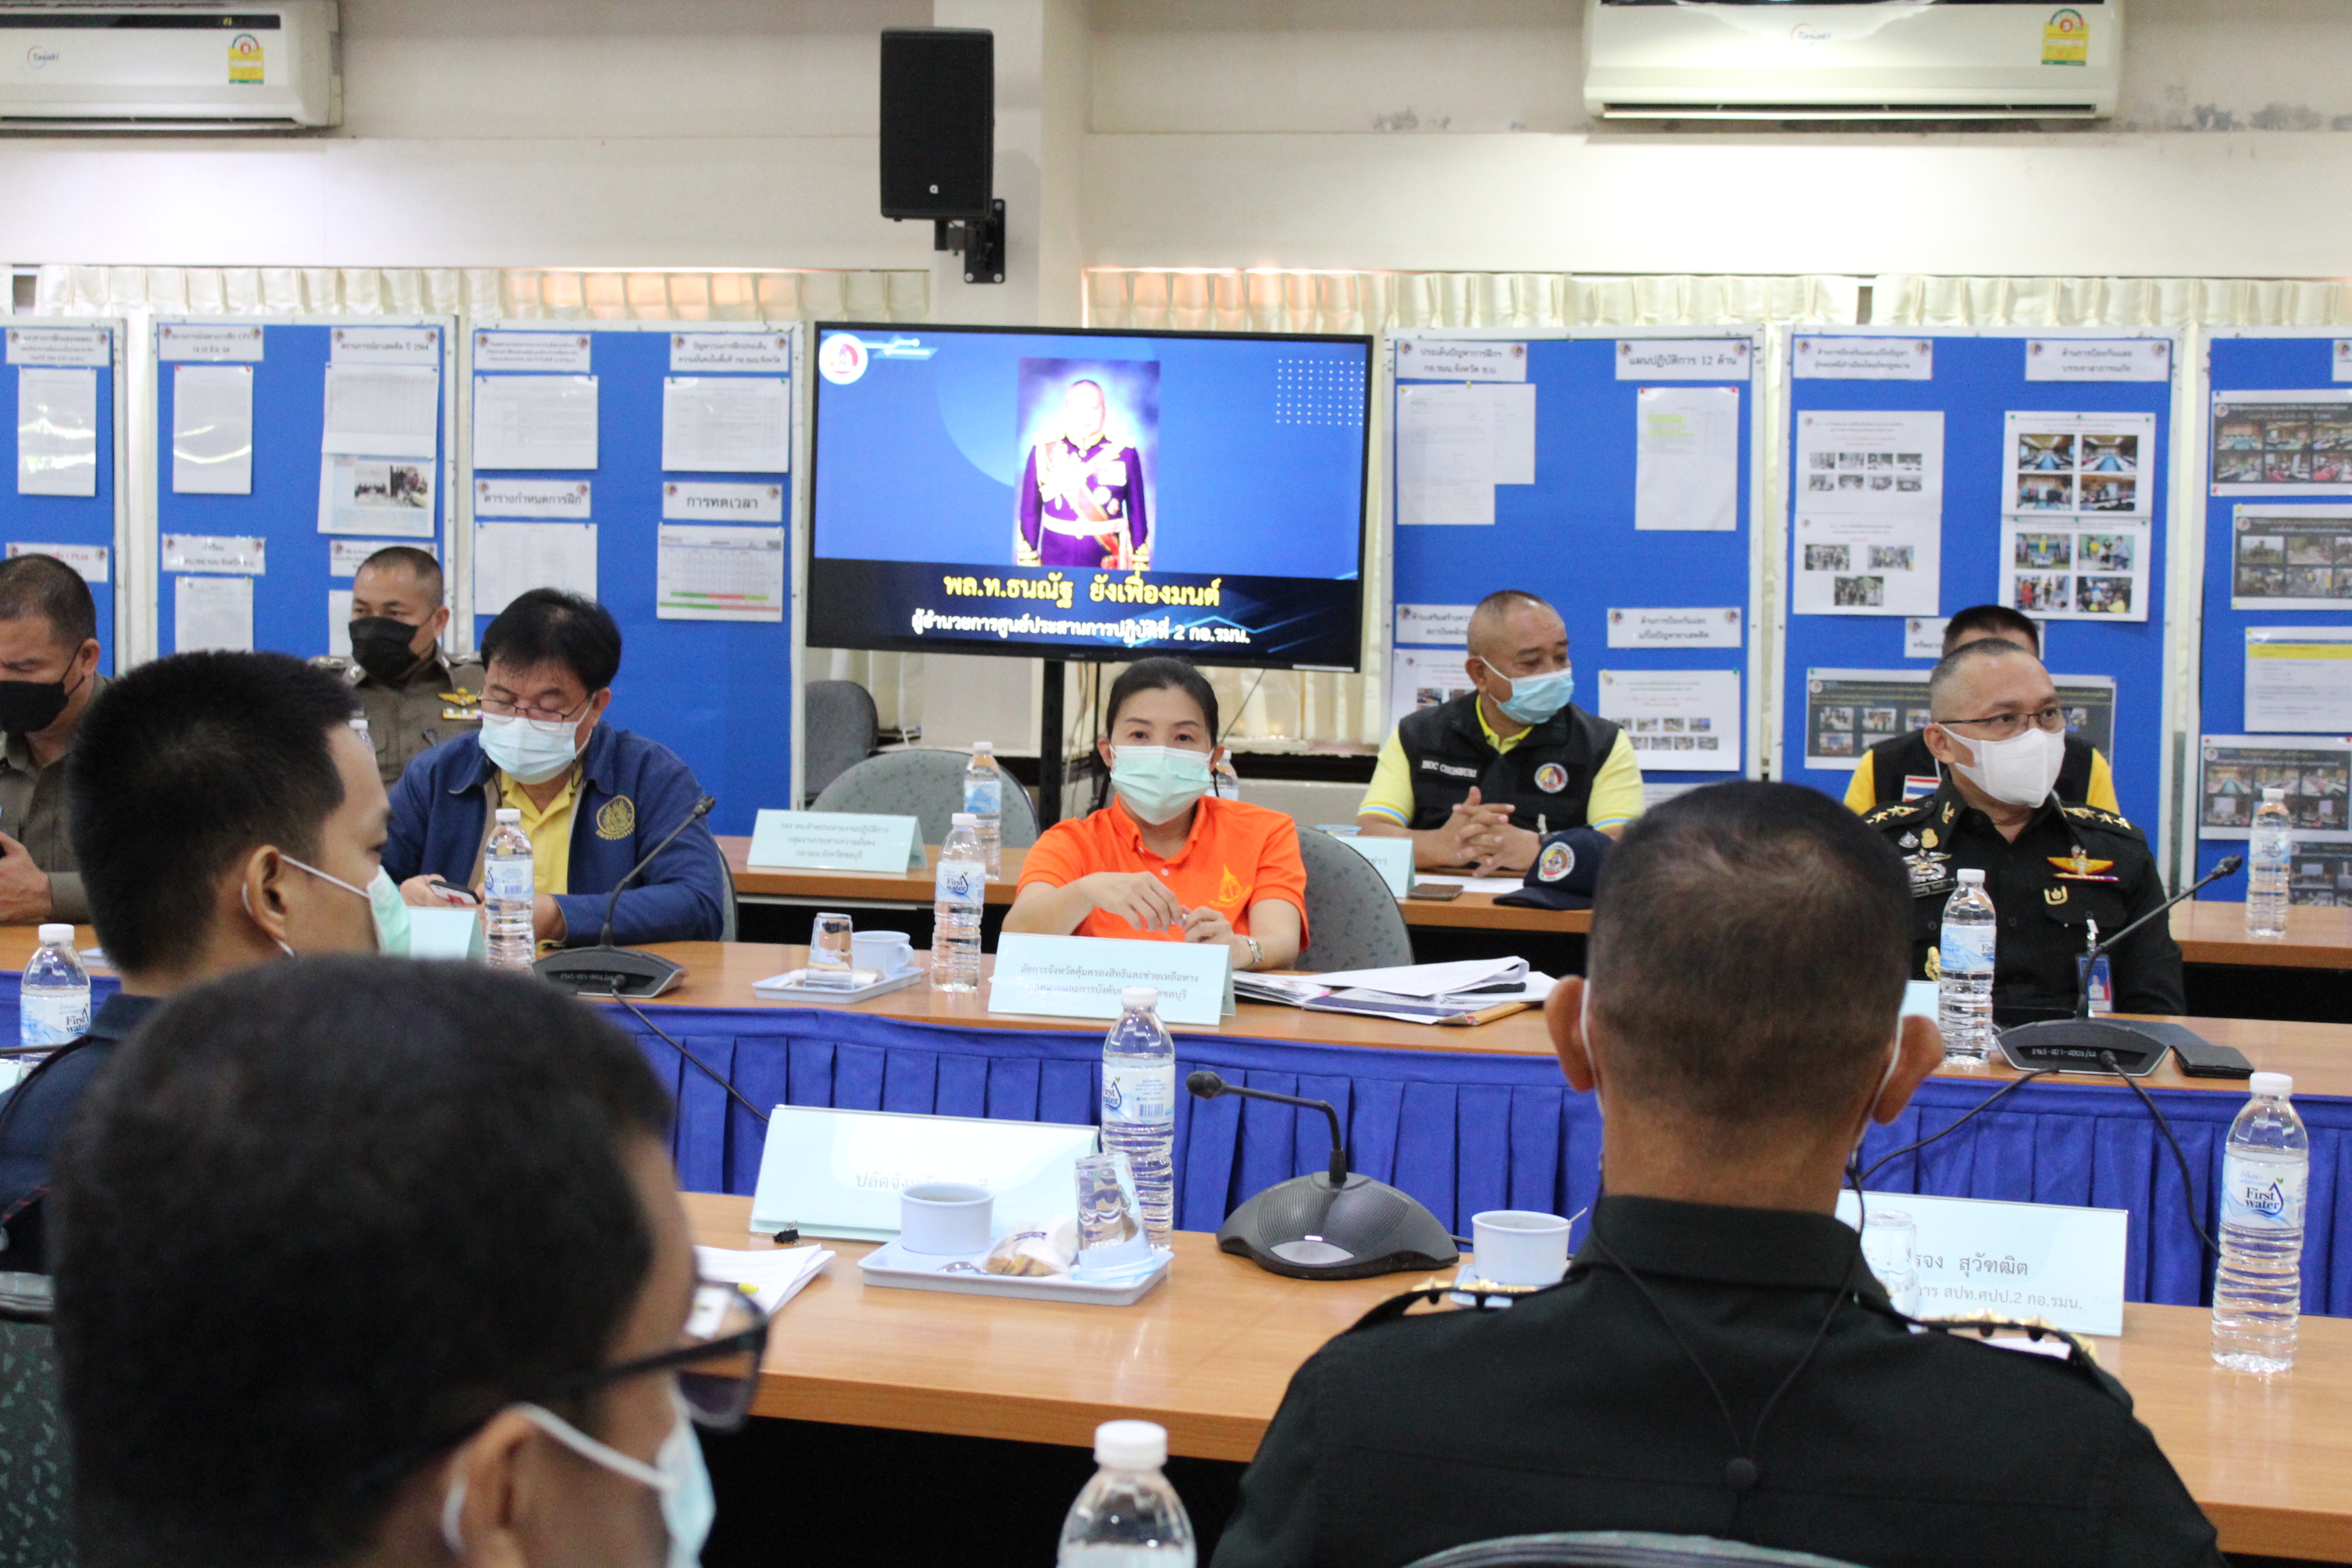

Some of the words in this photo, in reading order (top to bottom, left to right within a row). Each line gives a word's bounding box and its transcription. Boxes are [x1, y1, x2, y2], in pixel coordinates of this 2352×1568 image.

[1701, 356, 1713, 365] 12
[943, 572, 1074, 609] พล.ท.ธนณัฐ
[1089, 570, 1222, 606] ยังเฟื่องมนต์
[1174, 627, 1186, 640] 2
[947, 878, 963, 886] First
[2247, 1187, 2274, 1200] First
[2245, 1199, 2280, 1209] water
[1944, 1286, 2022, 1305] สปท.ศปป.2
[2027, 1294, 2083, 1309] กอ.รมน.
